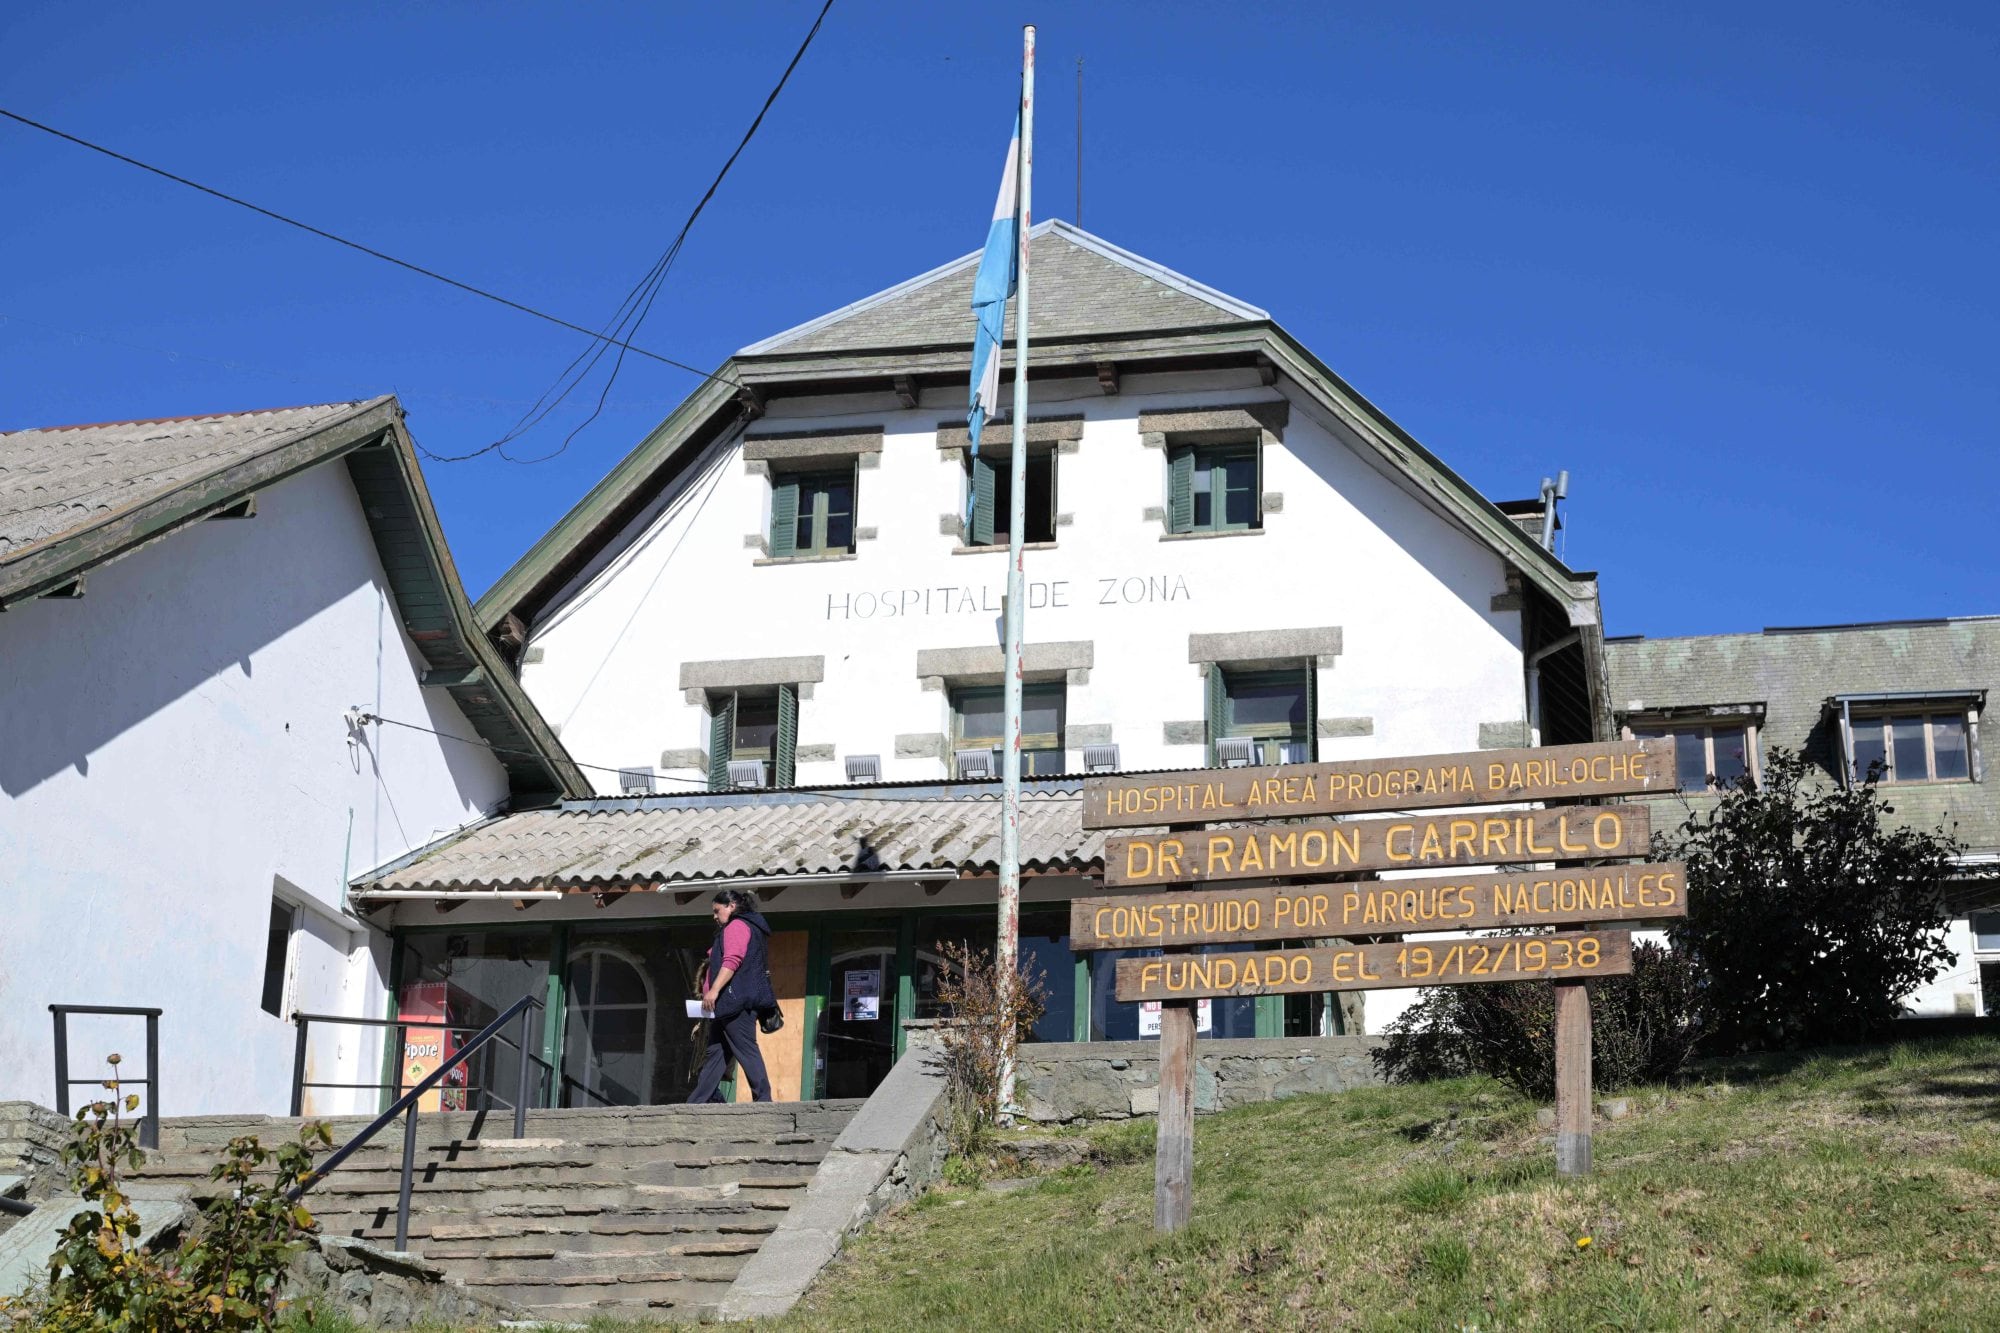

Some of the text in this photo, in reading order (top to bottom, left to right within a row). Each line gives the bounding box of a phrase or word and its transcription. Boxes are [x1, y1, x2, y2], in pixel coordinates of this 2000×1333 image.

[827, 574, 1191, 620] HOSPITAL DE ZONA
[1107, 753, 1648, 816] HOSPITAL AREA PROGRAMA BARILOCHE
[1386, 812, 1623, 862] CARRILLO
[1095, 873, 1676, 939] CONSTRUIDO POR PARQUES NACIONALES
[1141, 937, 1601, 993] FUNDADO EL 19/12/1938
